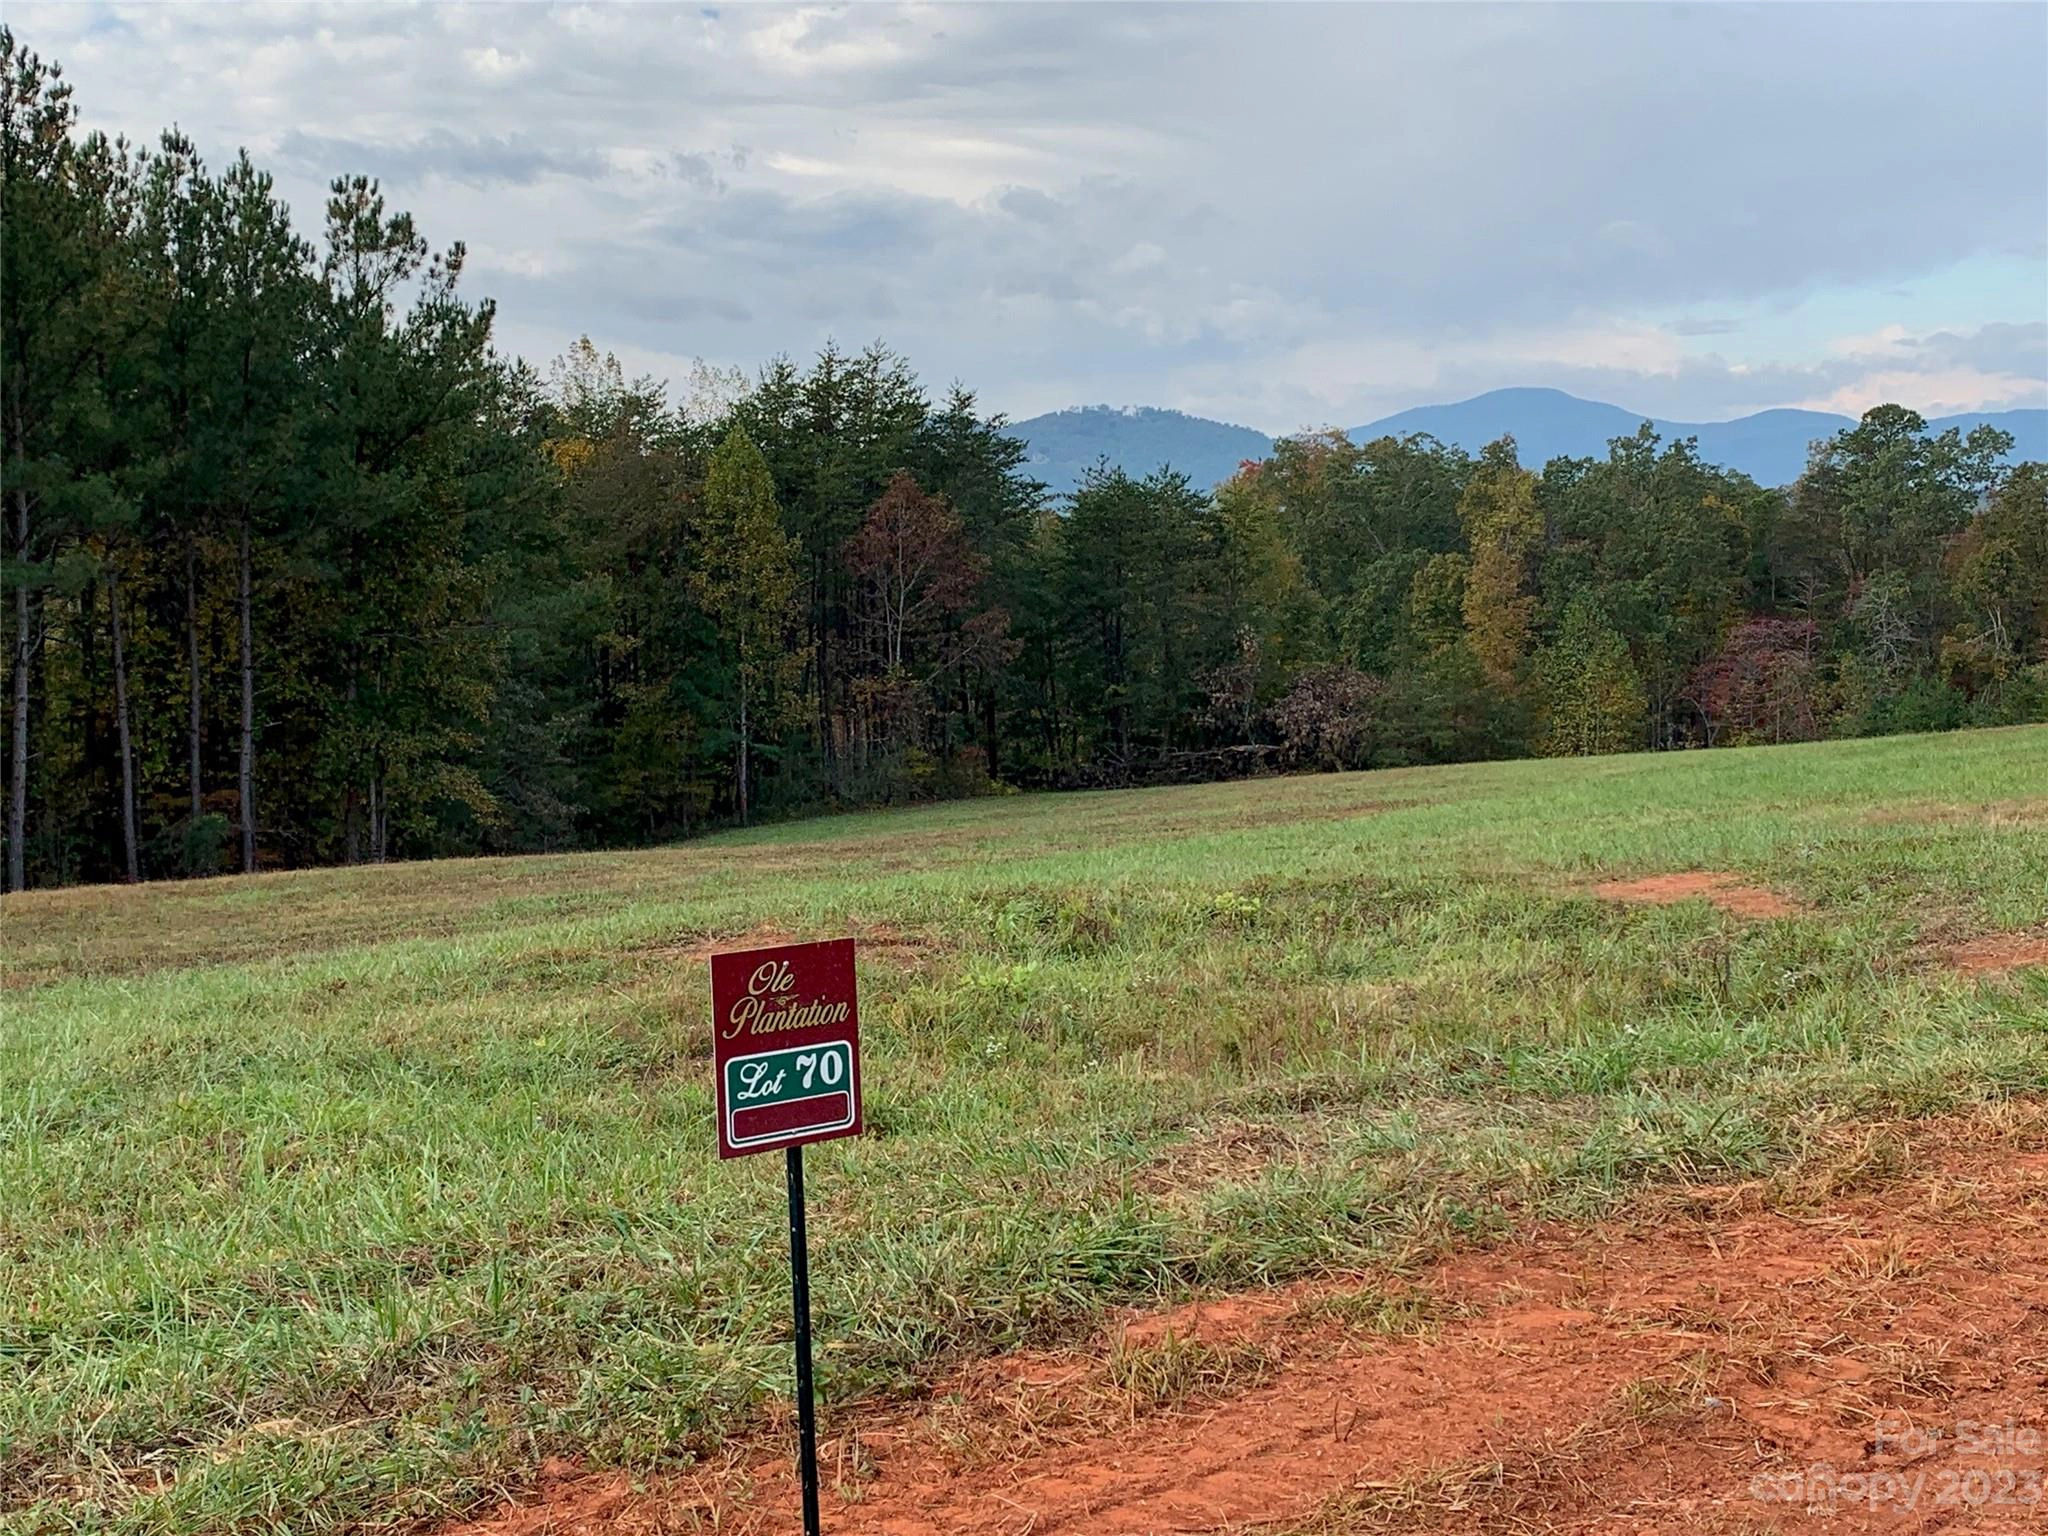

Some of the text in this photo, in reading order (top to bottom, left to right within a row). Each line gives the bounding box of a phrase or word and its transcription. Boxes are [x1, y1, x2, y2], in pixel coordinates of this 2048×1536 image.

[722, 995, 850, 1039] Plantation
[737, 1050, 843, 1100] Lot 70
